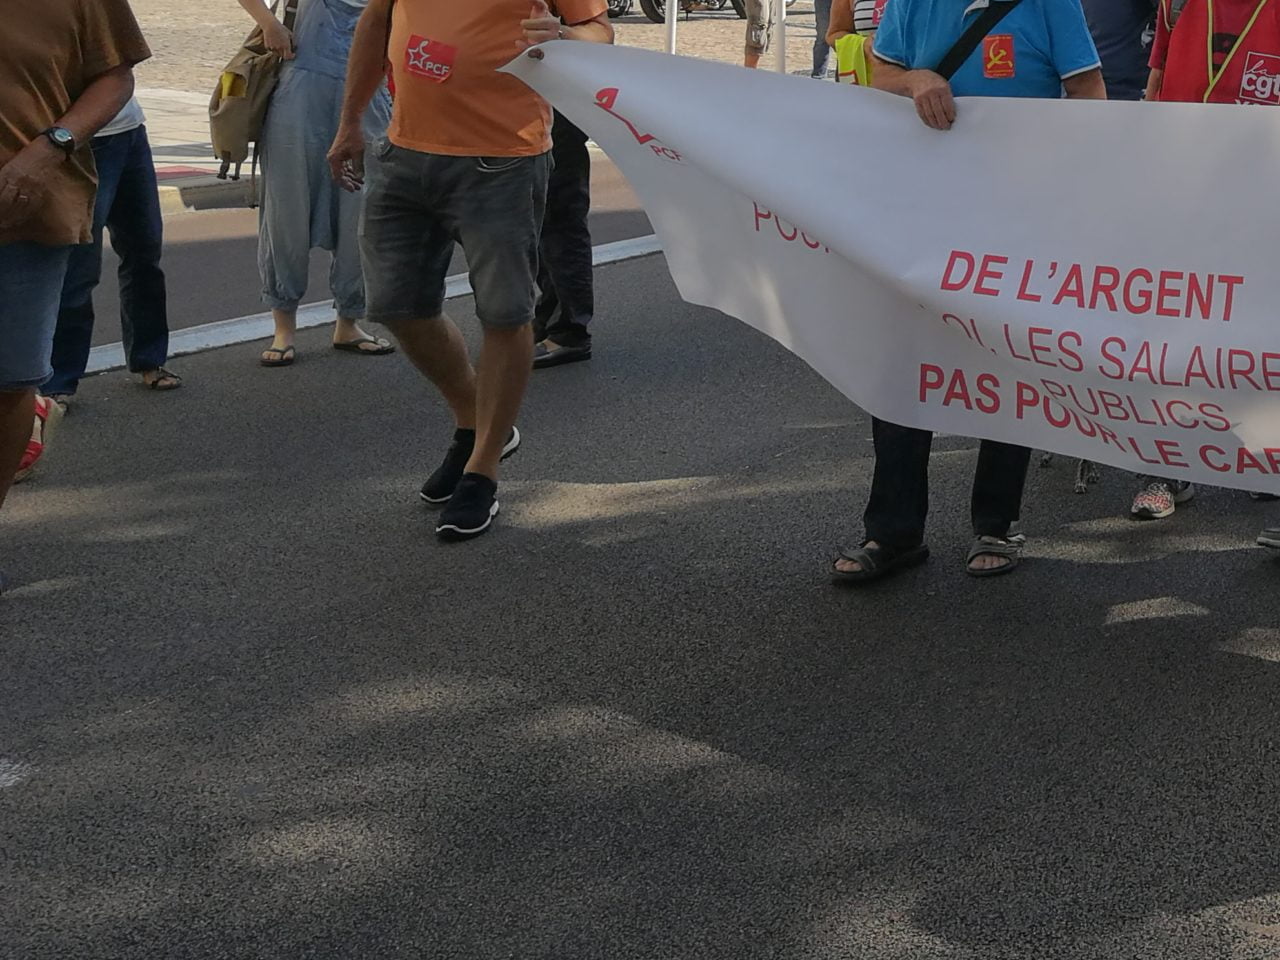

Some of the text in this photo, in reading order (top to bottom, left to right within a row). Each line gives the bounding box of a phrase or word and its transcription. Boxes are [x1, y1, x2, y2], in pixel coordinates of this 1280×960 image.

[425, 61, 450, 75] PCF
[650, 144, 682, 161] PCF
[941, 250, 1244, 322] DE L'ARGENT
[1004, 324, 1083, 373] LES
[919, 363, 1000, 415] PAS
[1128, 437, 1190, 468] LE
[1040, 379, 1231, 432] PUBLICS
